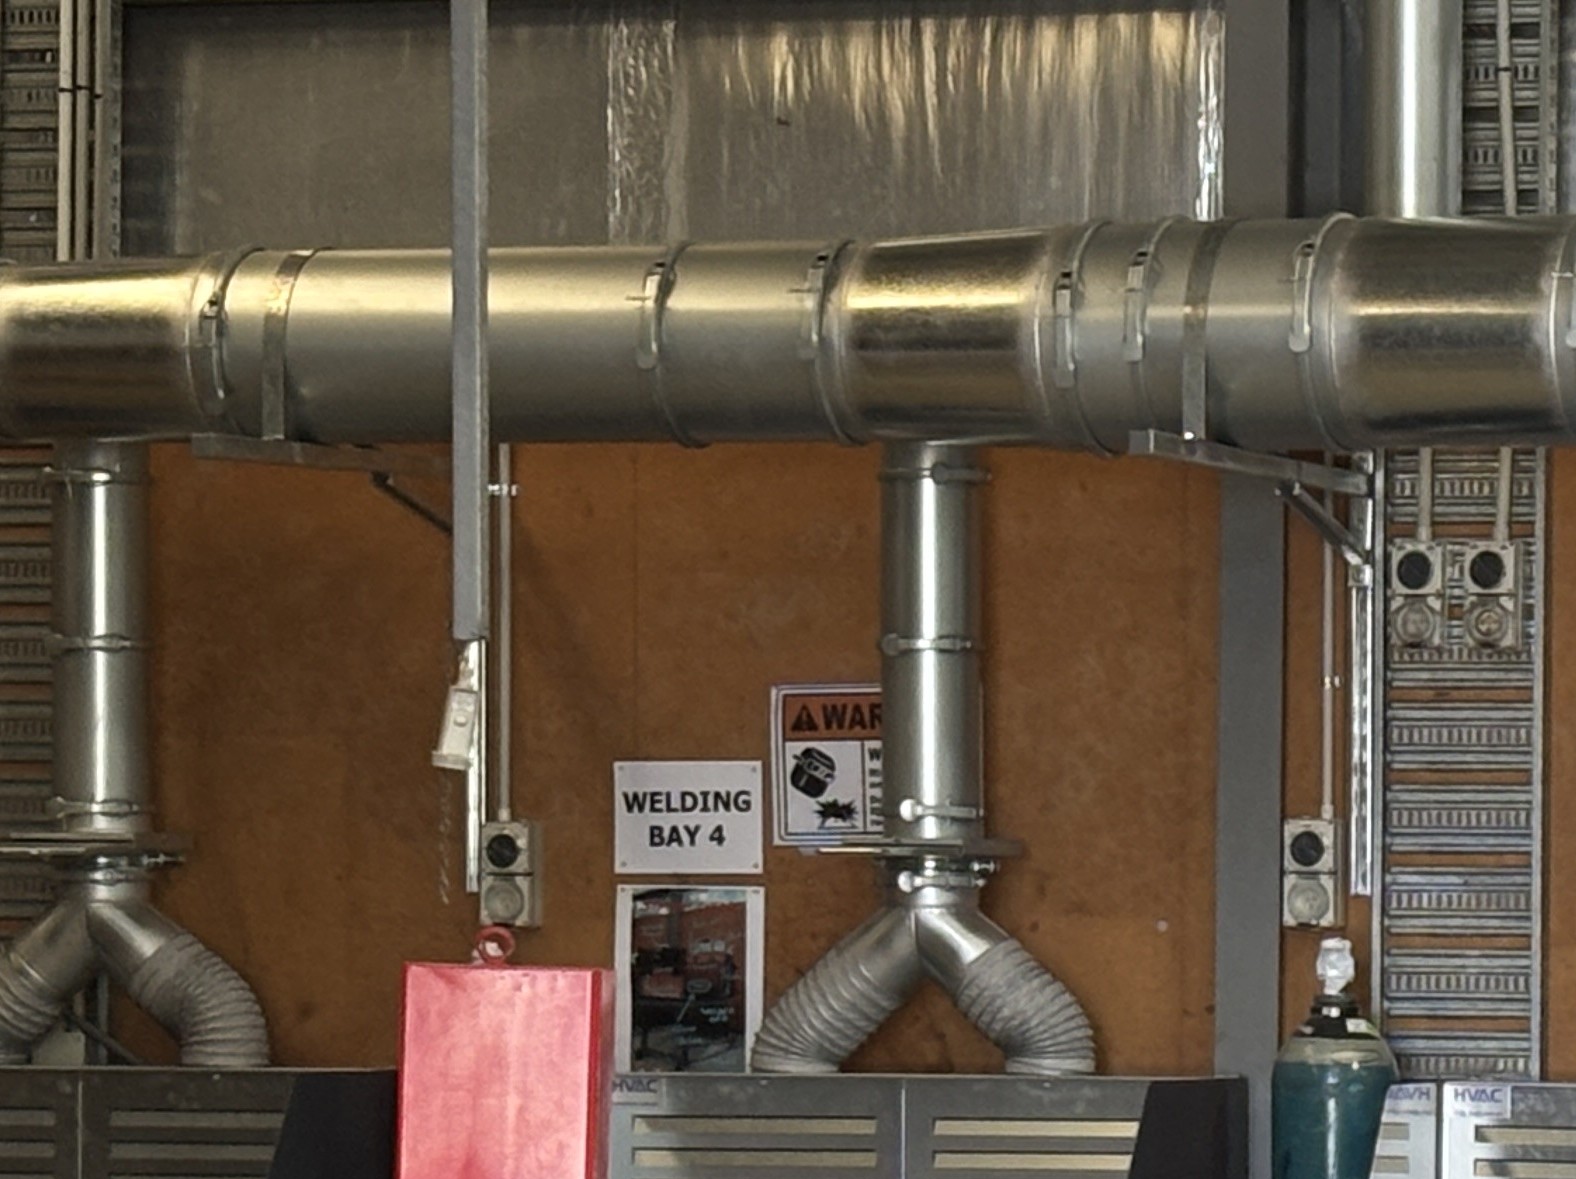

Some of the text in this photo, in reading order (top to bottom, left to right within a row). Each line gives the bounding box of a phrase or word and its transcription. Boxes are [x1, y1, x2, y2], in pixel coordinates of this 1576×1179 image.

[822, 703, 882, 731] WAR
[622, 790, 752, 813] WELDING
[649, 824, 726, 847] BAY 4
[611, 1079, 658, 1094] HVAC
[1454, 1087, 1503, 1102] HVAC
